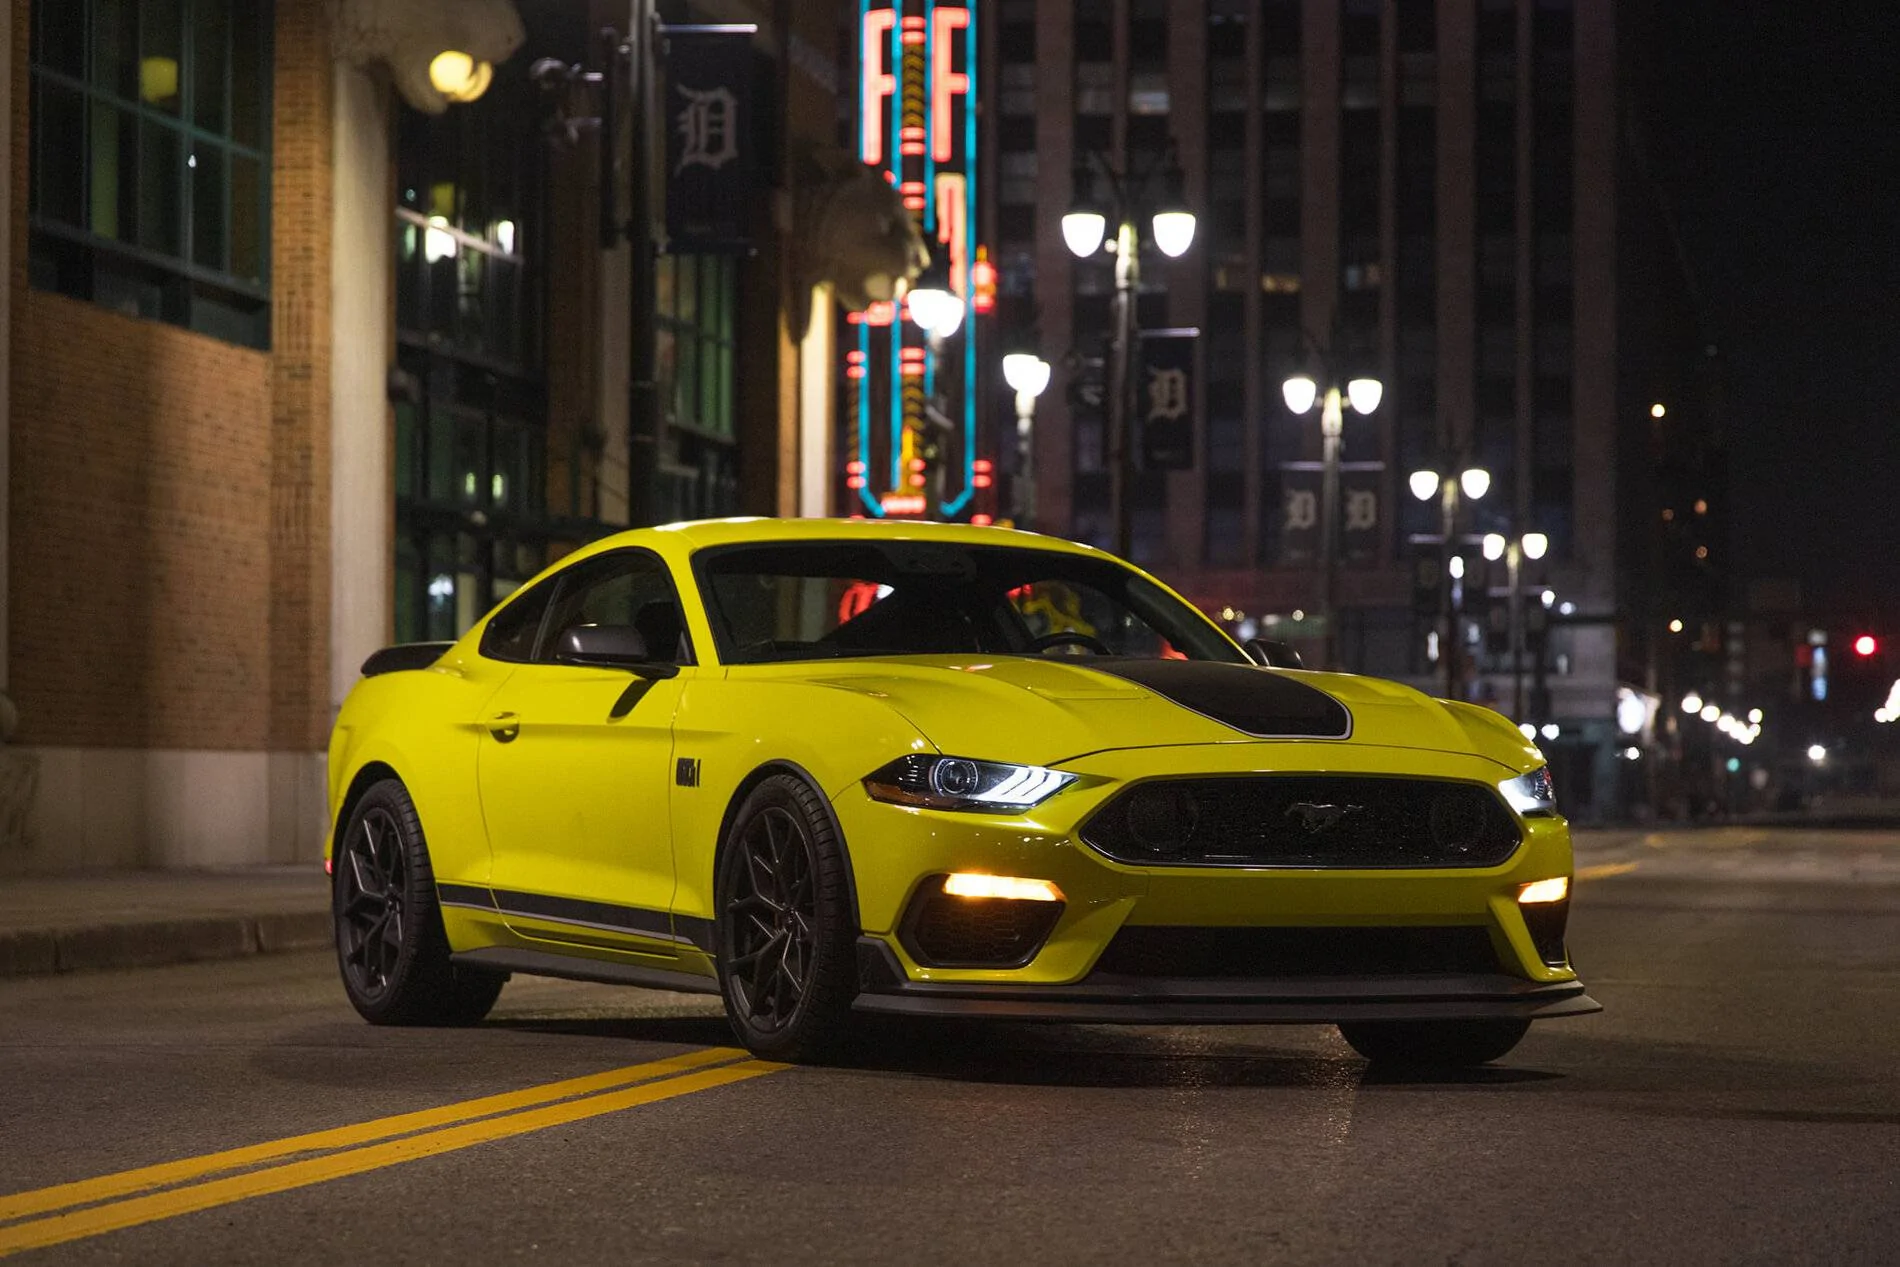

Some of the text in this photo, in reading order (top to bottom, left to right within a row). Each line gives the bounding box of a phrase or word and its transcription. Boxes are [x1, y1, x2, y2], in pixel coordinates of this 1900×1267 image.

[674, 83, 738, 178] D
[1146, 365, 1188, 422] D
[1285, 487, 1316, 530] D
[1346, 486, 1376, 530] D
